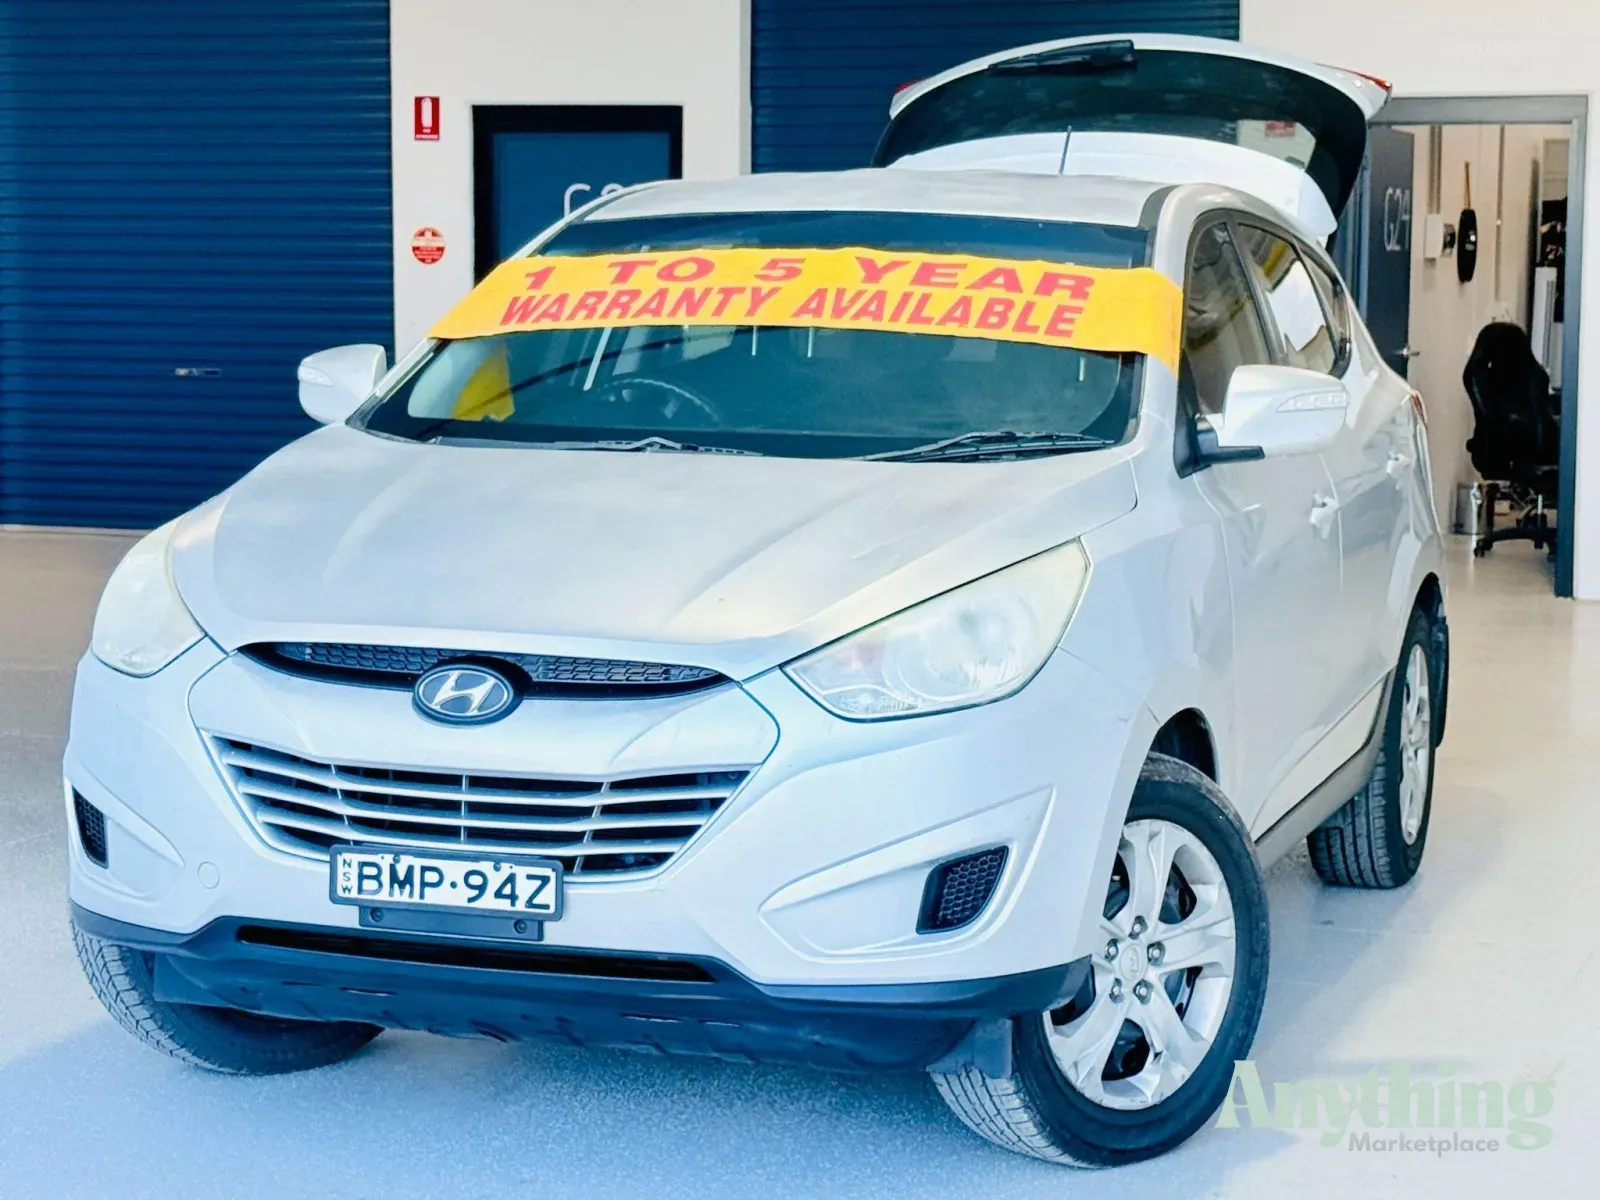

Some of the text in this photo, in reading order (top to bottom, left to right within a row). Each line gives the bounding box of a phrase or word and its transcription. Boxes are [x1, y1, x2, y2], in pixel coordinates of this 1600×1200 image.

[525, 256, 1095, 300] 1 TO 5 YEAR
[499, 286, 1084, 338] WARRANTY AVAILABLE
